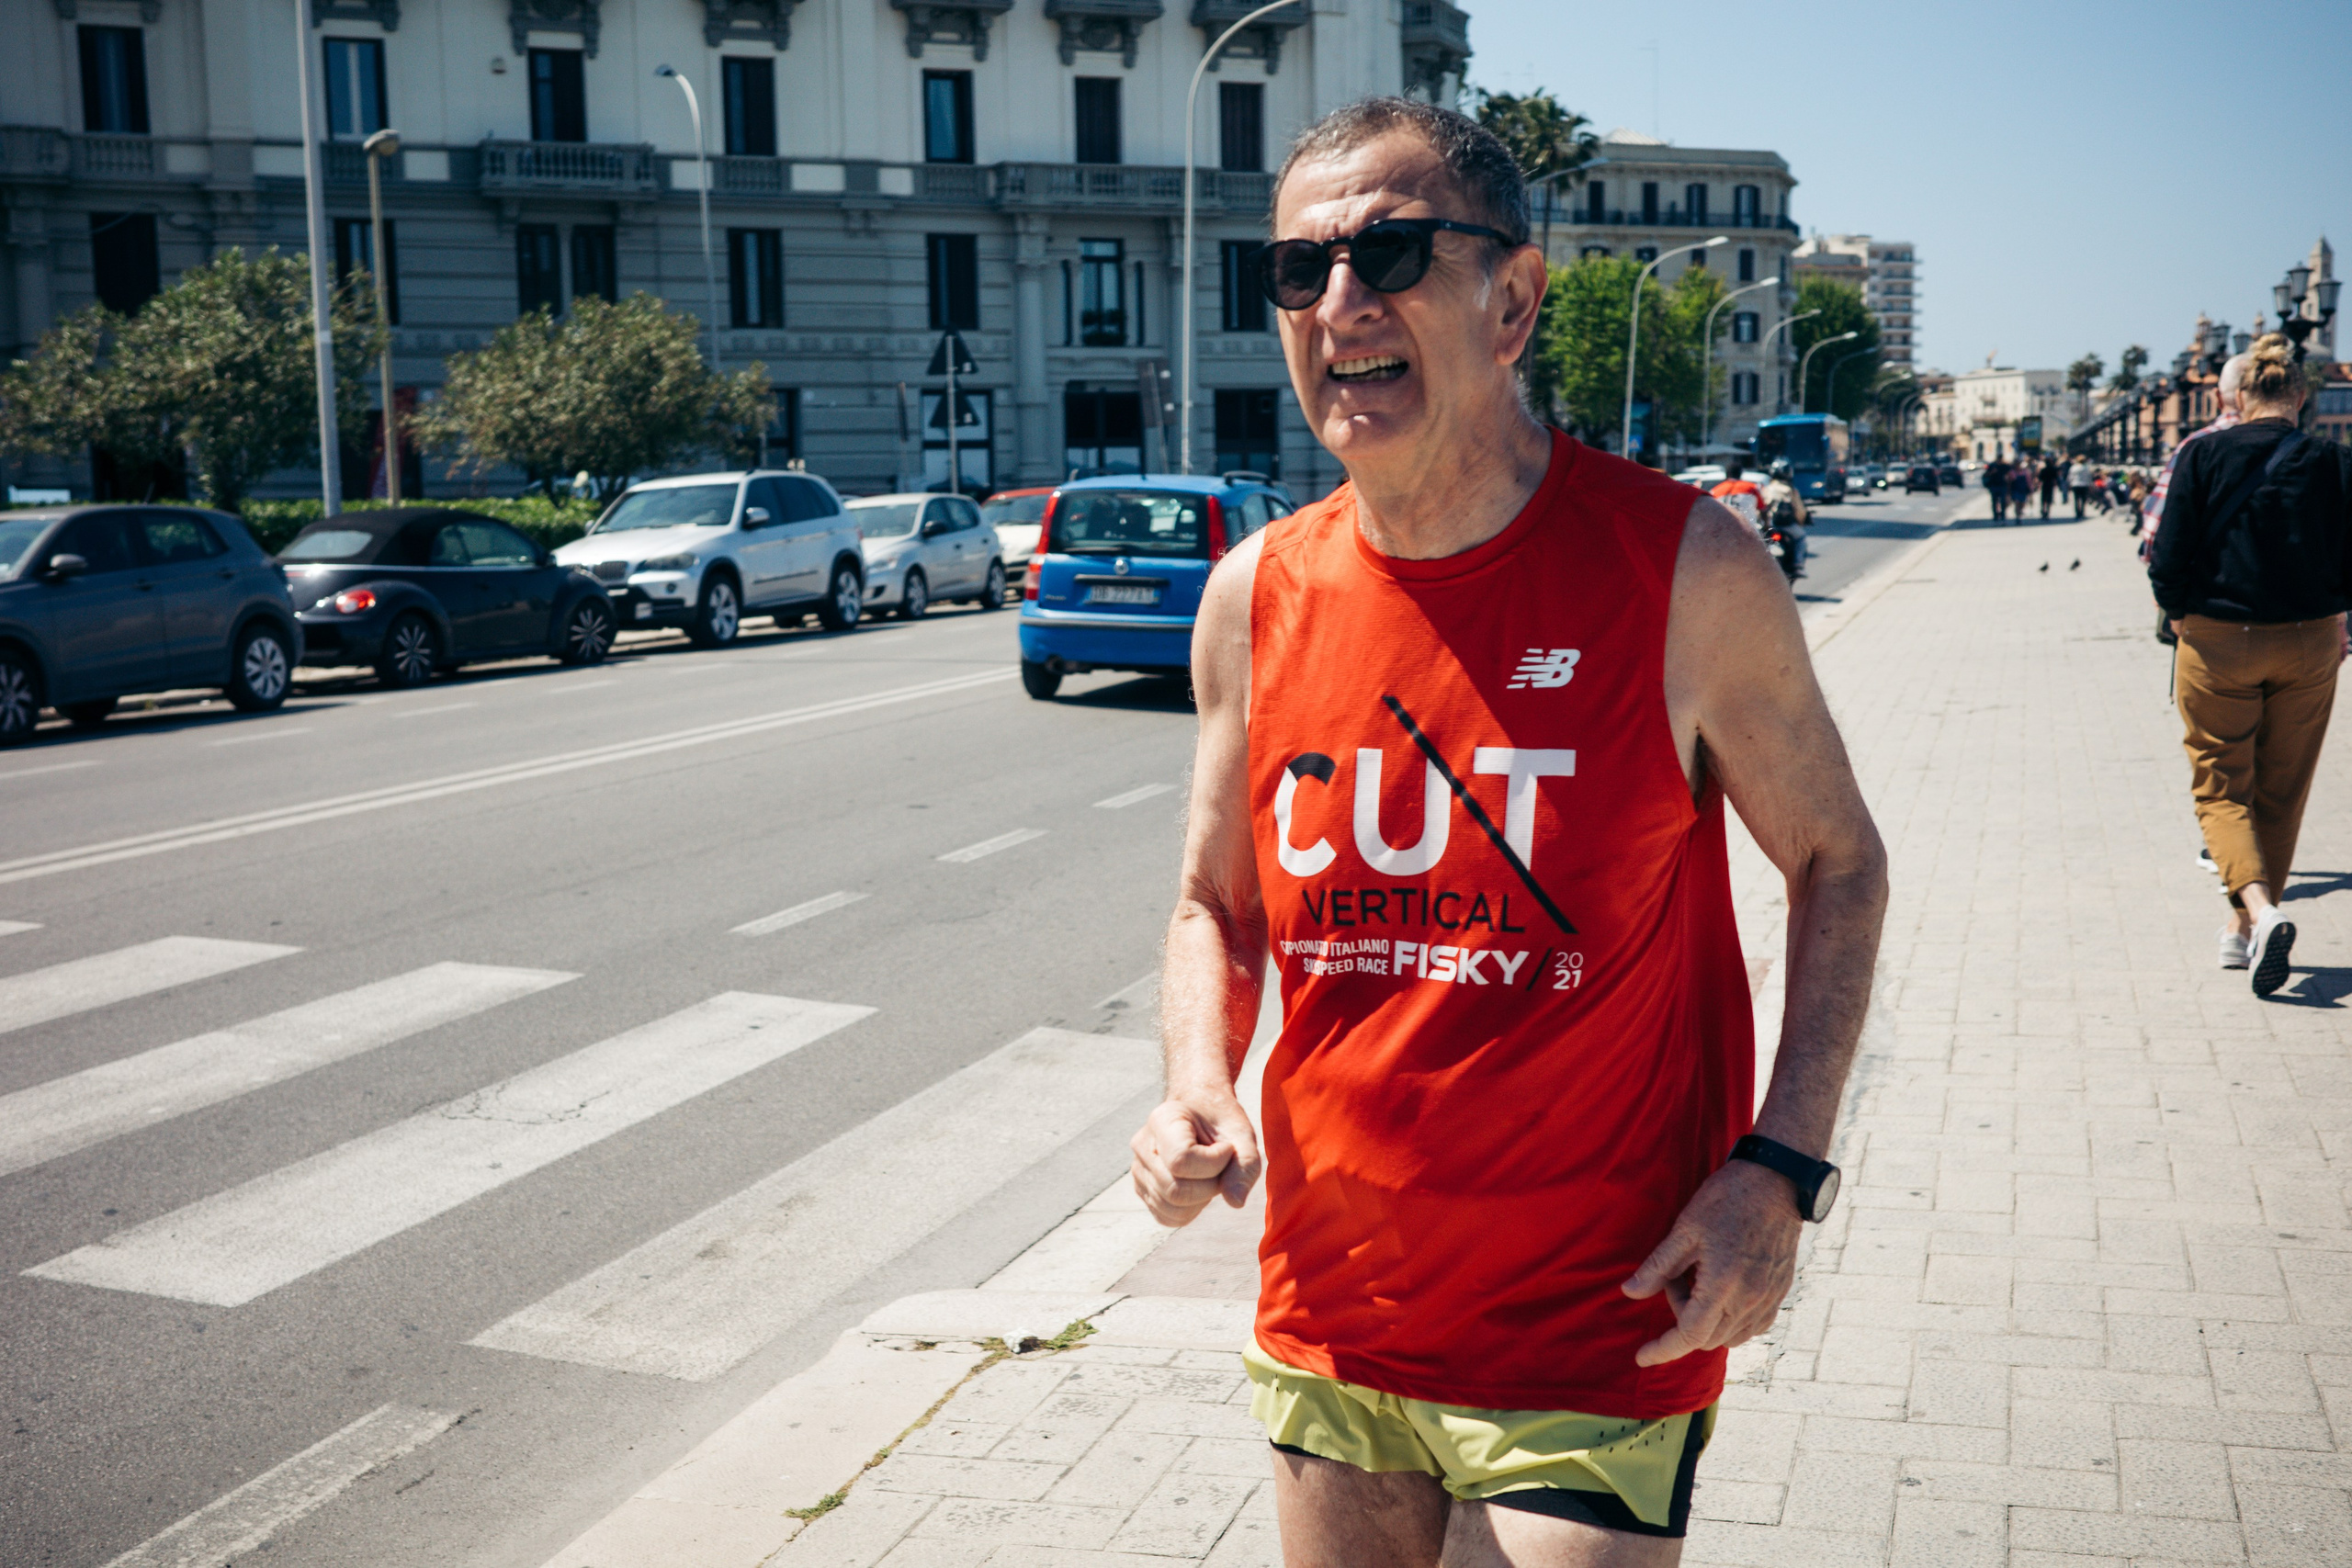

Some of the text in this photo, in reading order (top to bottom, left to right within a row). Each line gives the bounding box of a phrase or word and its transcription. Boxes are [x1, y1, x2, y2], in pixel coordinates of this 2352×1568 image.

[1273, 746, 1577, 877] CUT
[1302, 887, 1525, 933] VERTICAL
[1330, 939, 1389, 957] ITALIANO
[1356, 956, 1388, 976] RACE
[1393, 940, 1531, 986] FISKY
[1555, 952, 1584, 969] 20
[1553, 969, 1582, 990] 21
